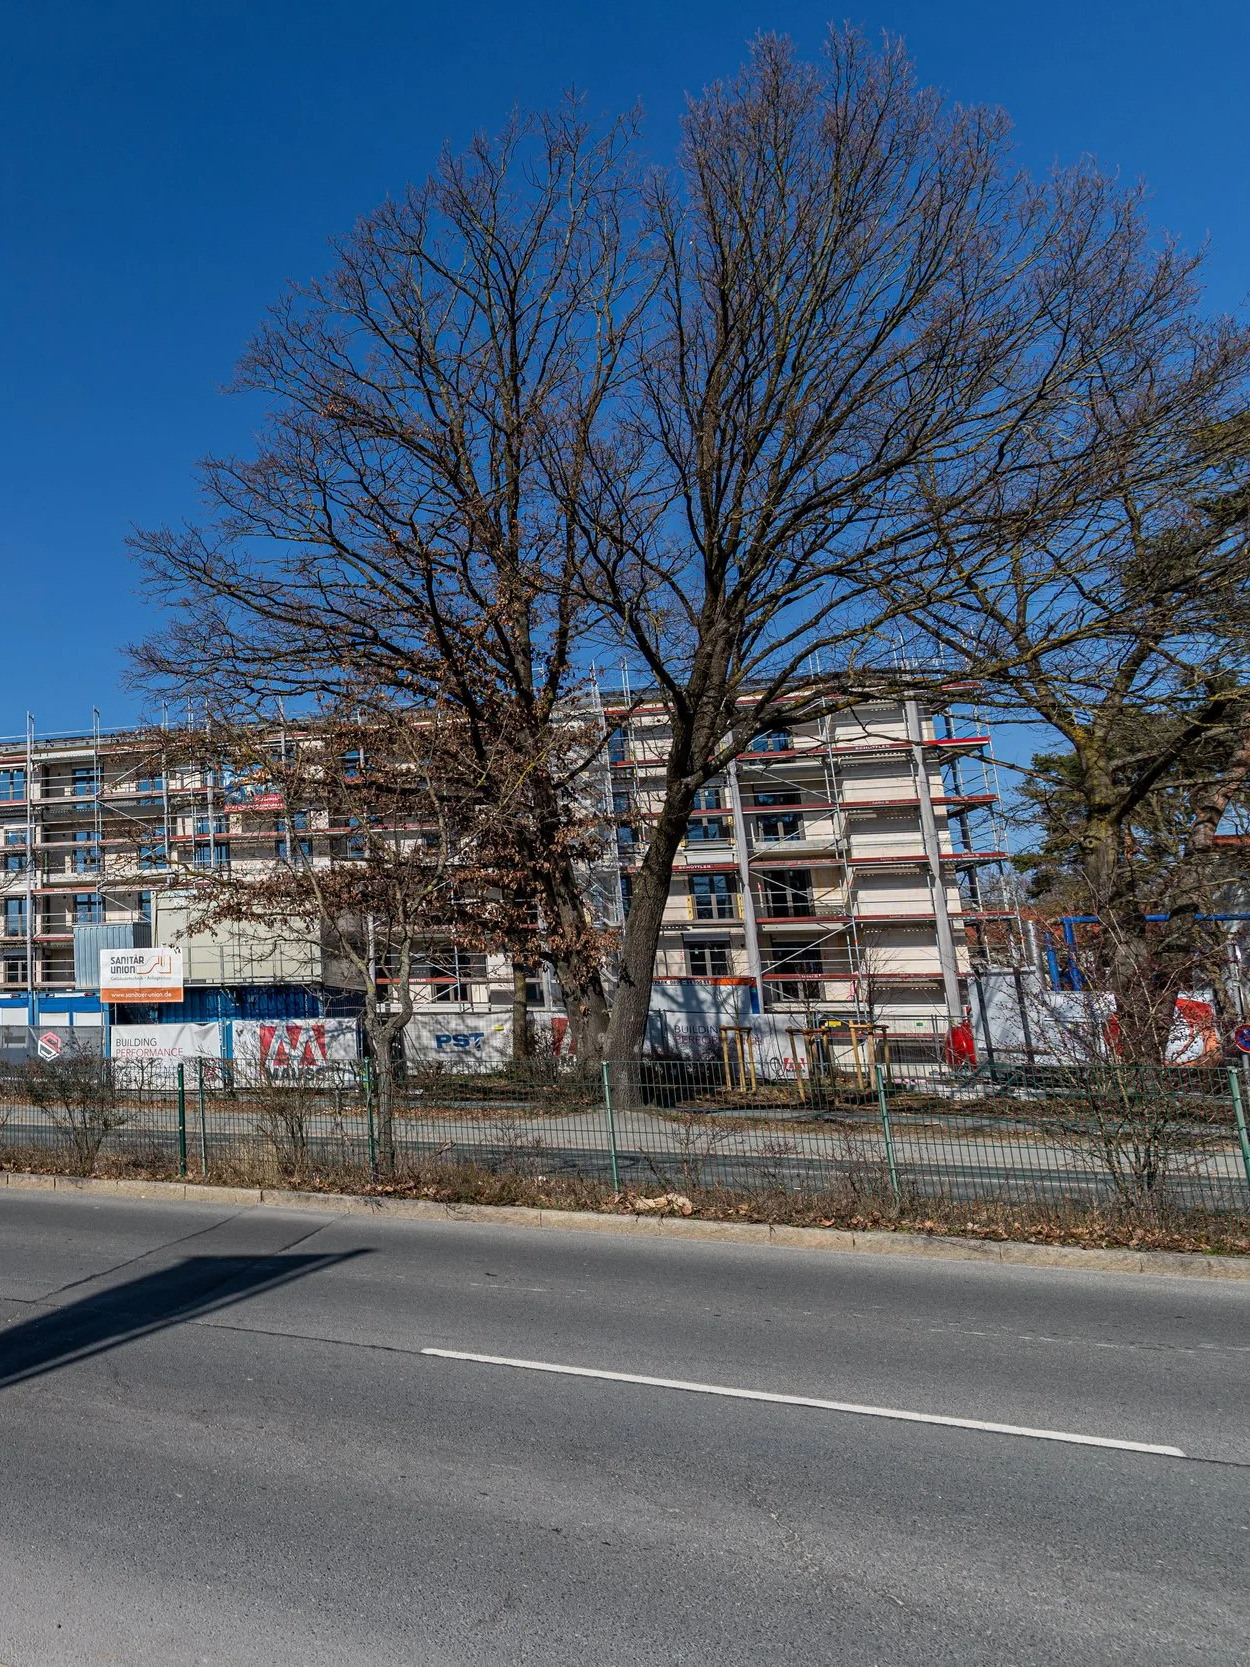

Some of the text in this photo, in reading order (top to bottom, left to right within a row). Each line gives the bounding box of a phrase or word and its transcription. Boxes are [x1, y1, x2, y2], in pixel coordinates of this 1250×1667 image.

[110, 954, 145, 965] SANITÄR
[110, 965, 136, 975] UNION
[674, 1024, 724, 1034] BUILDIN
[116, 1037, 158, 1047] BUILDING
[435, 1032, 485, 1051] PST
[116, 1047, 184, 1058] PERFORMANCE
